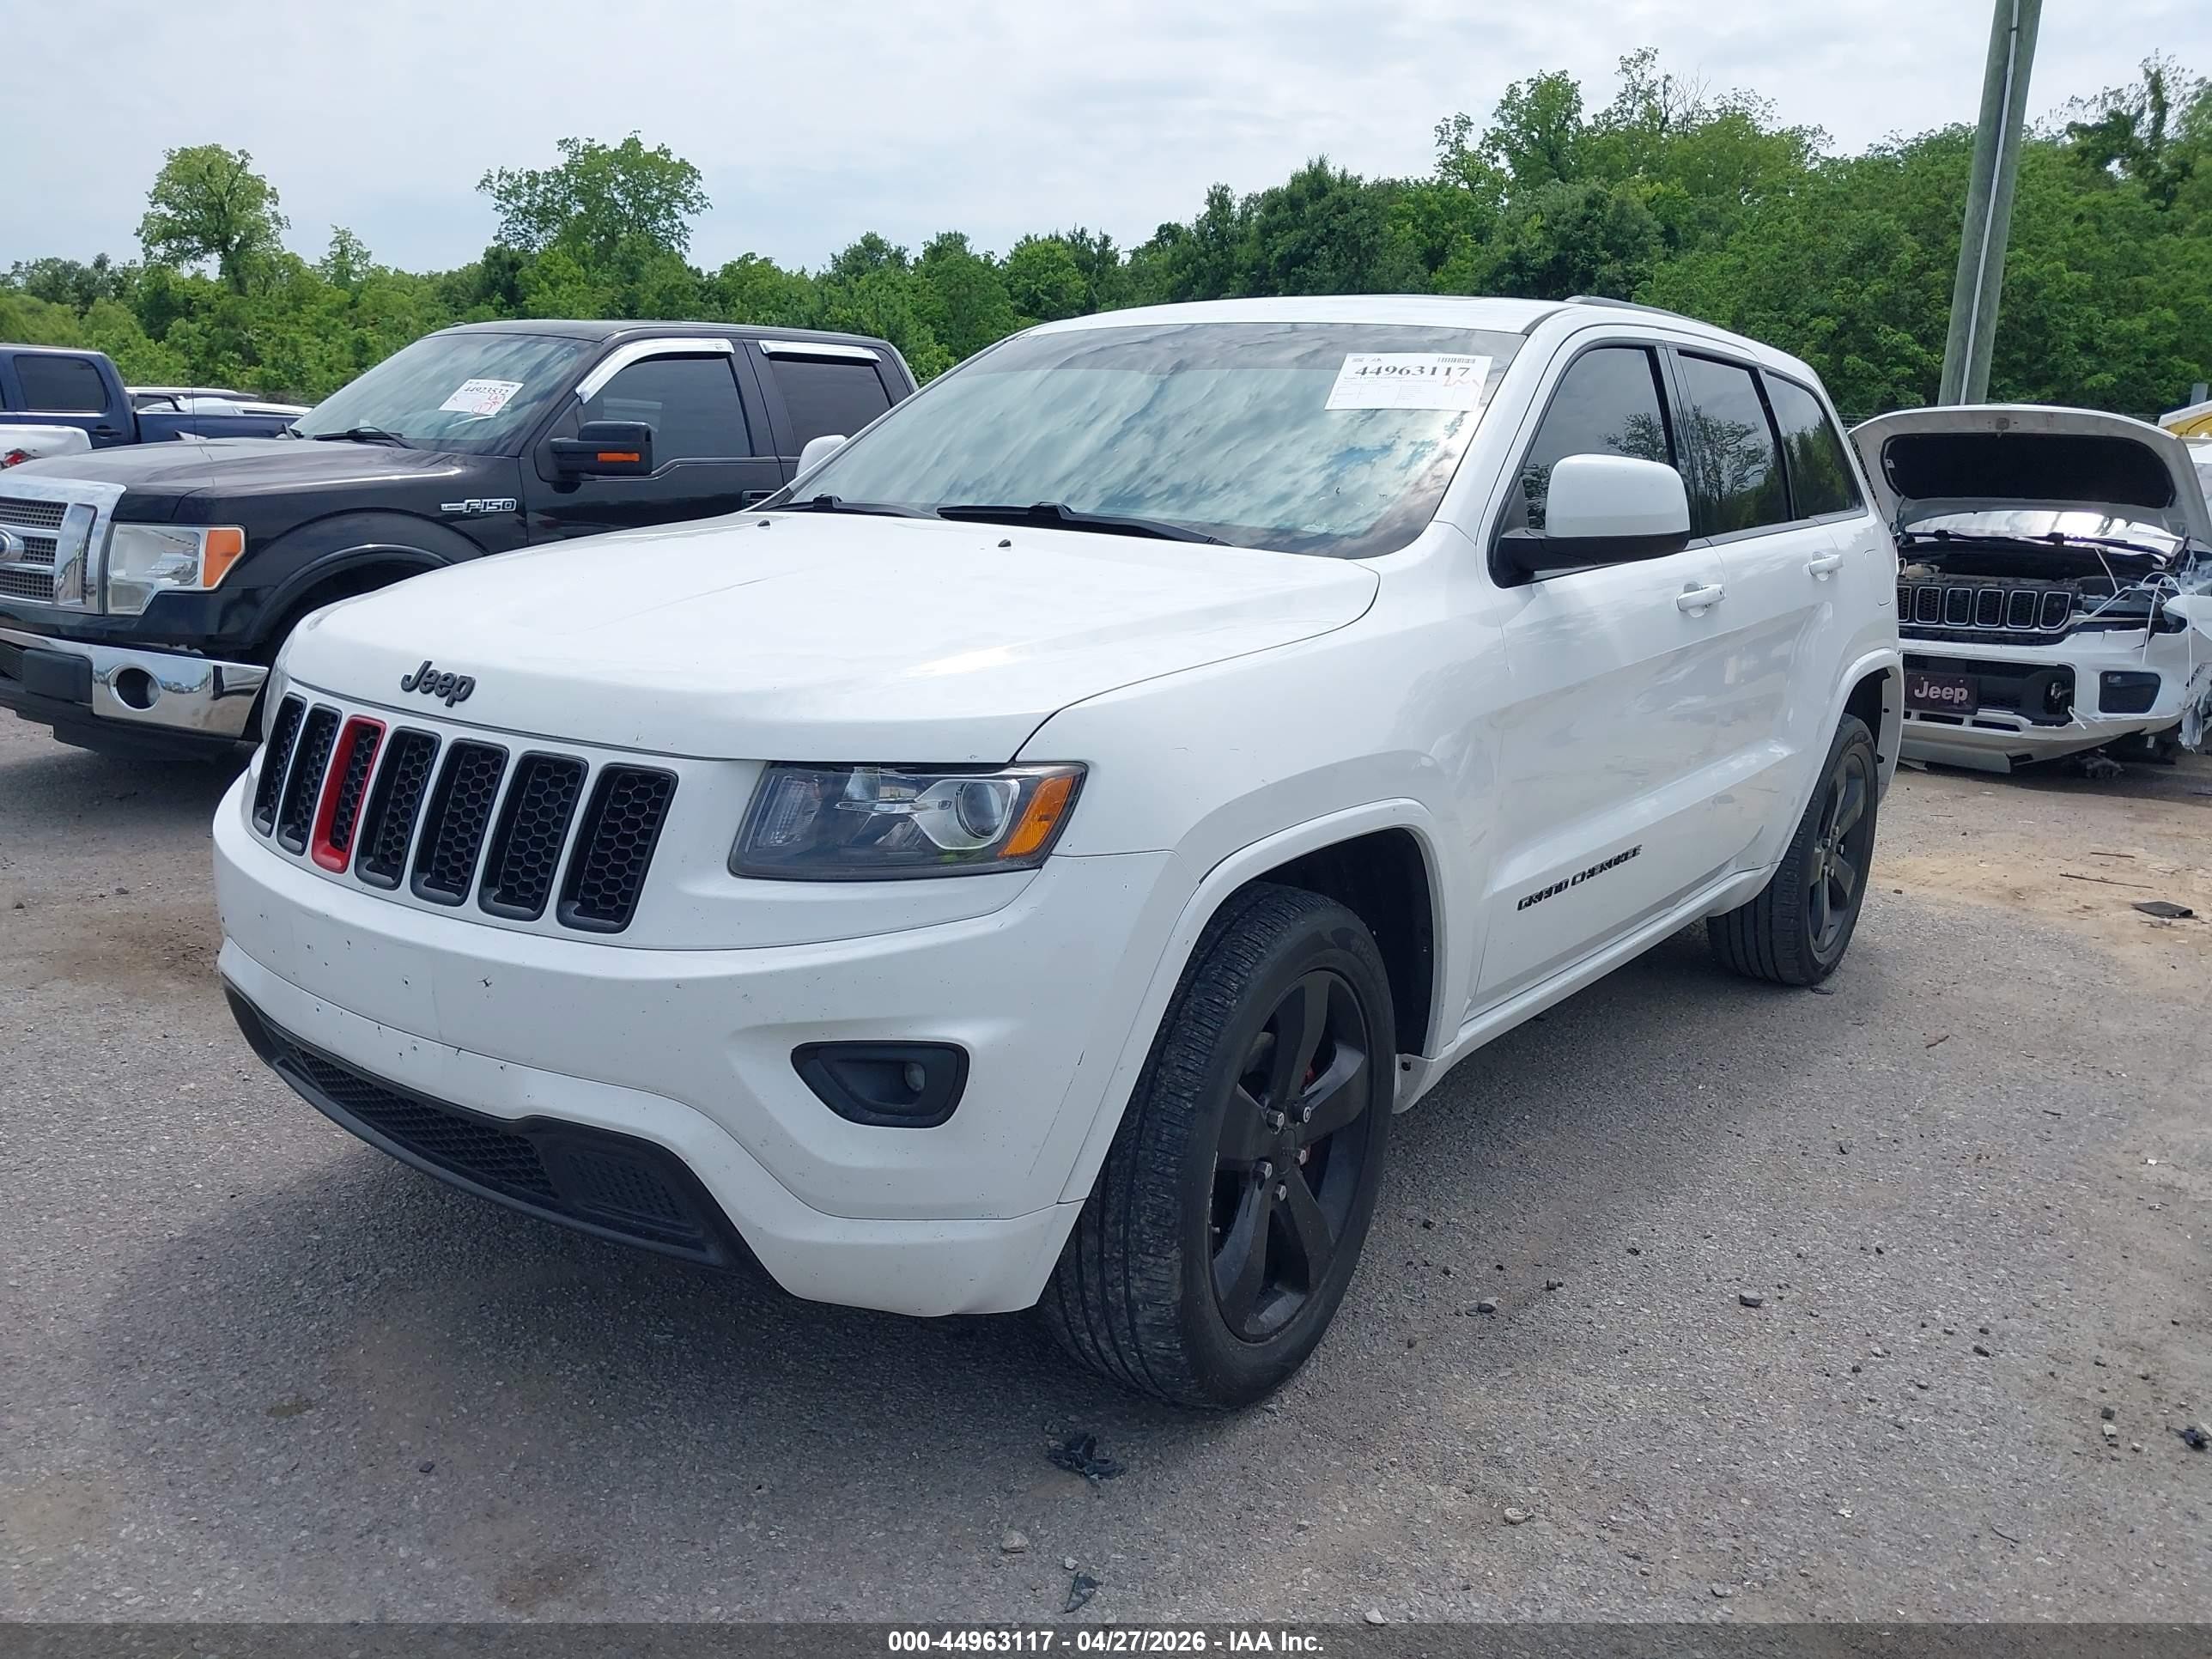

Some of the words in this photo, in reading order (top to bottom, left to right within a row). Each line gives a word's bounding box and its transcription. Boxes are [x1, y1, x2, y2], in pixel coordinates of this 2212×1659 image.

[1354, 366, 1471, 377] 44963117
[401, 660, 477, 708] Jeep
[1914, 681, 1968, 703] Jeep
[1516, 878, 1570, 911] GRAND
